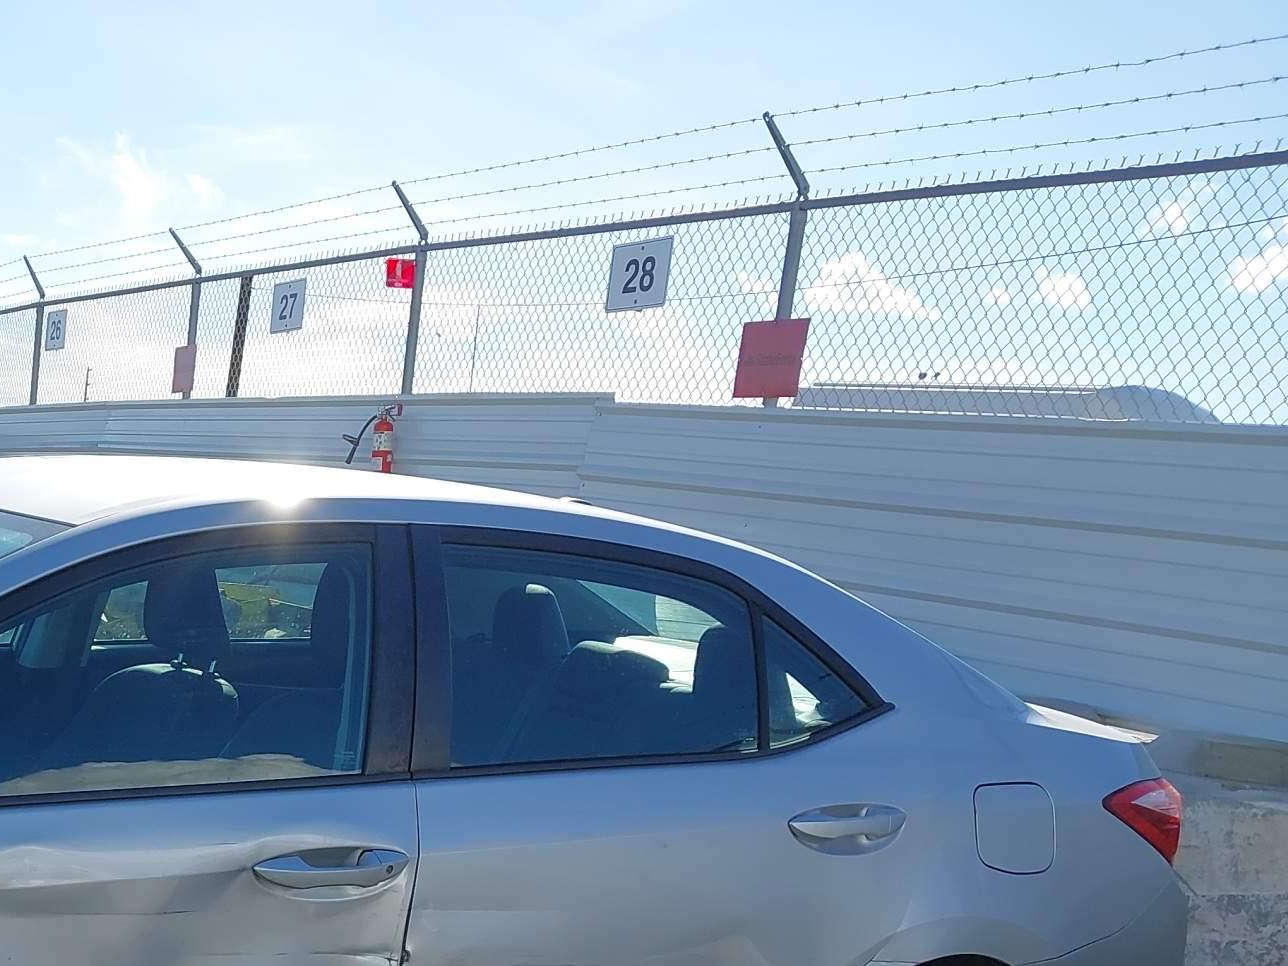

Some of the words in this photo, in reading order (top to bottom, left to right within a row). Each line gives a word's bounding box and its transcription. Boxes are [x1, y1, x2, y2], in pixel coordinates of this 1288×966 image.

[622, 256, 656, 294] 28
[279, 293, 298, 320] 27
[50, 319, 62, 340] 26
